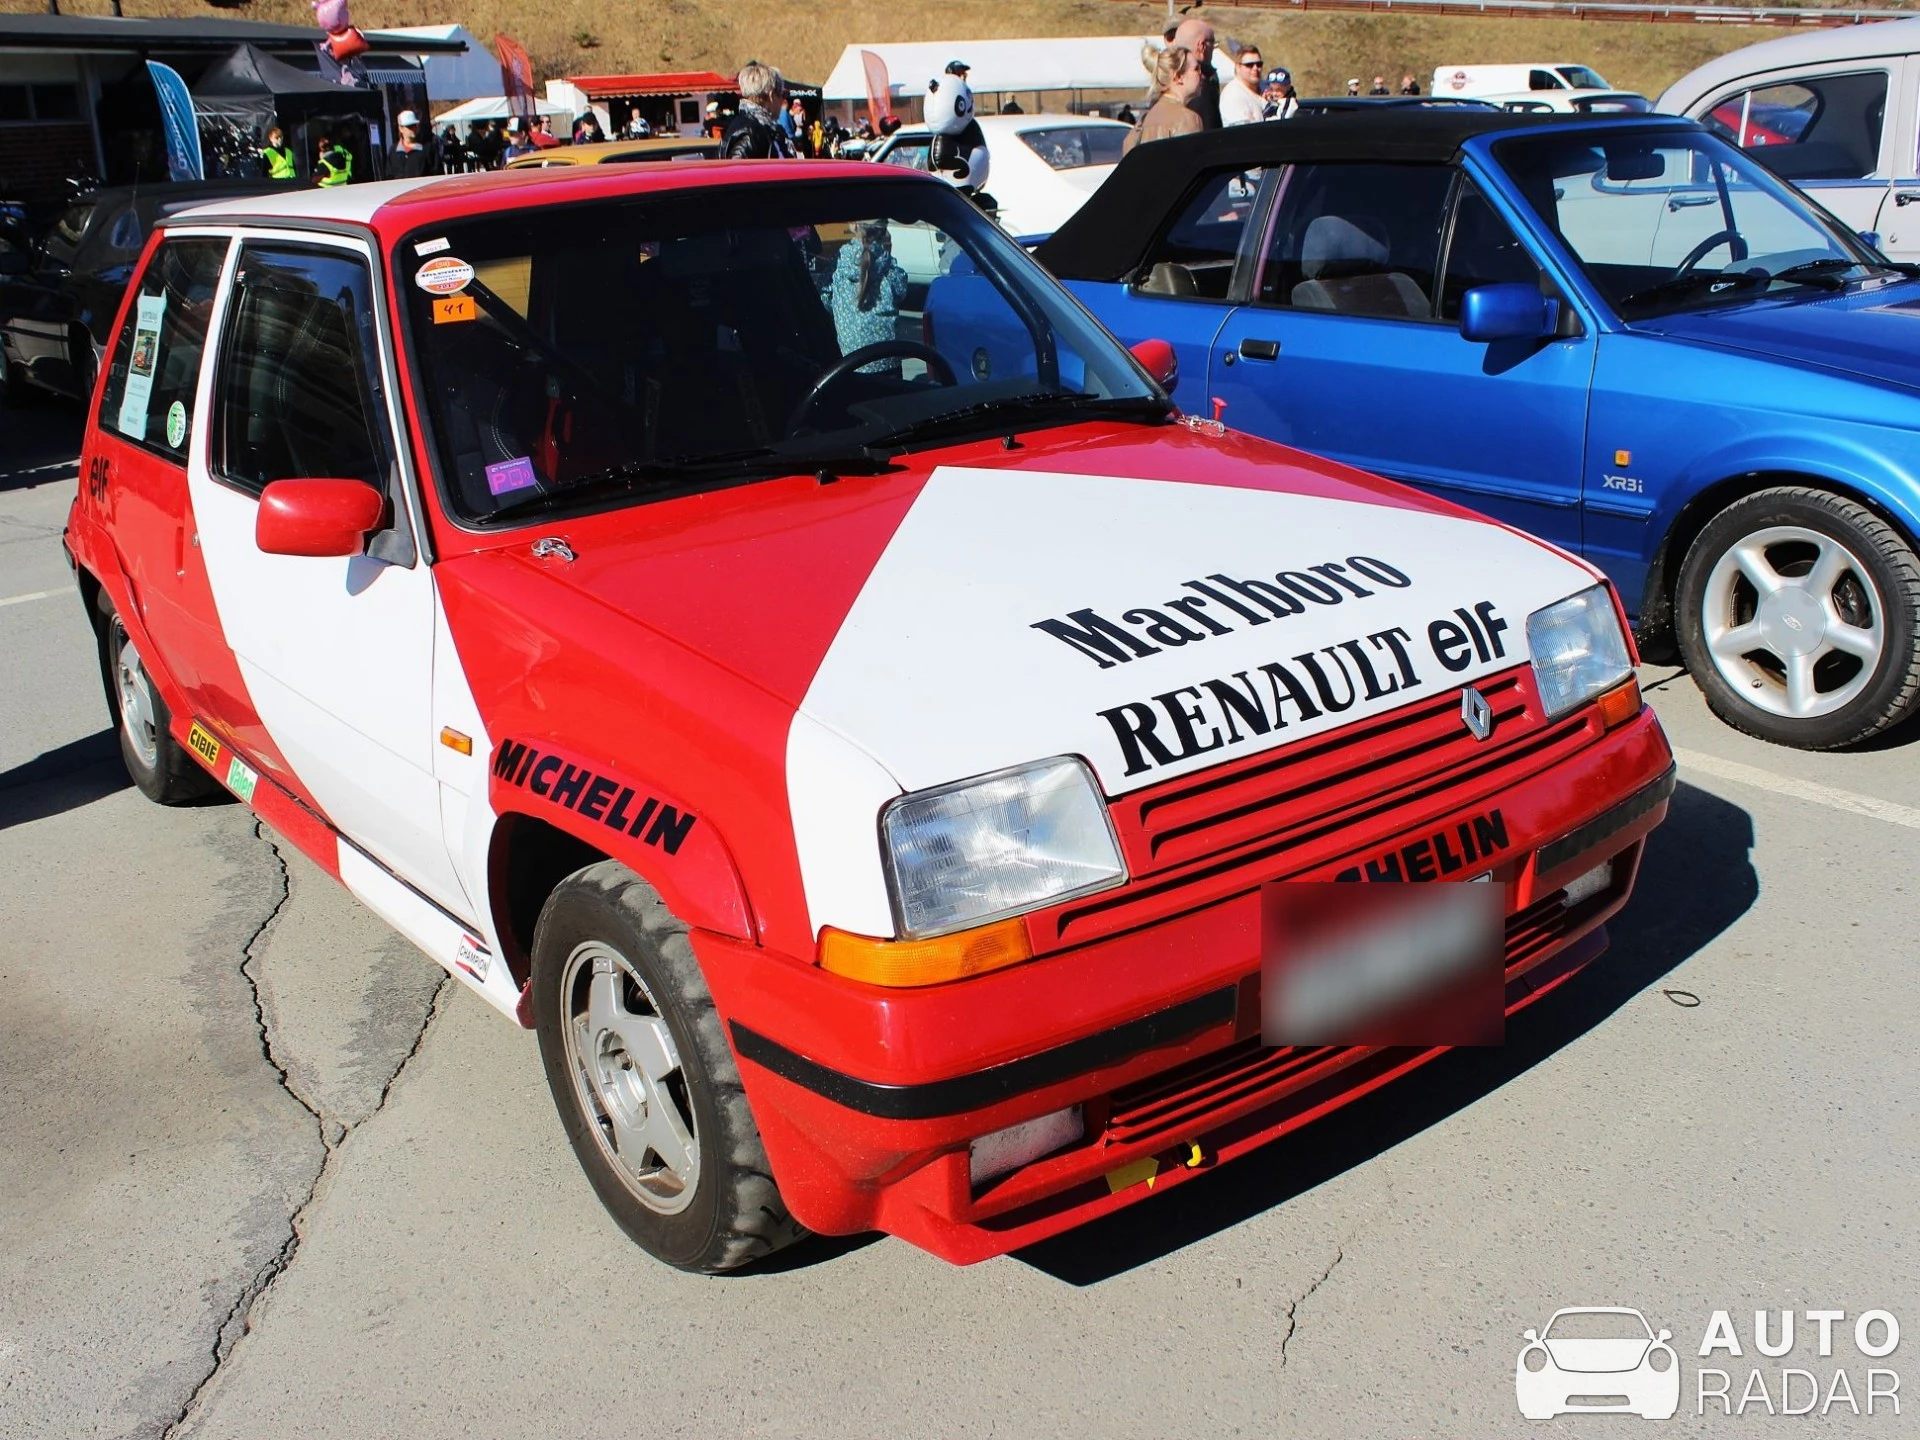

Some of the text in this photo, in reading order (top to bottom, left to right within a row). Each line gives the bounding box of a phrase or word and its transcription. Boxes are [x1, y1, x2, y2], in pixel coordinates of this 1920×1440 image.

[1602, 474, 1644, 494] XR3i
[1029, 555, 1413, 669] Marlboro
[1096, 600, 1509, 778] RENAULT elf
[189, 728, 218, 762] CIBIE
[228, 757, 255, 801] Valeo
[492, 738, 698, 856] MICHELIN
[459, 945, 490, 972] CHAMPION
